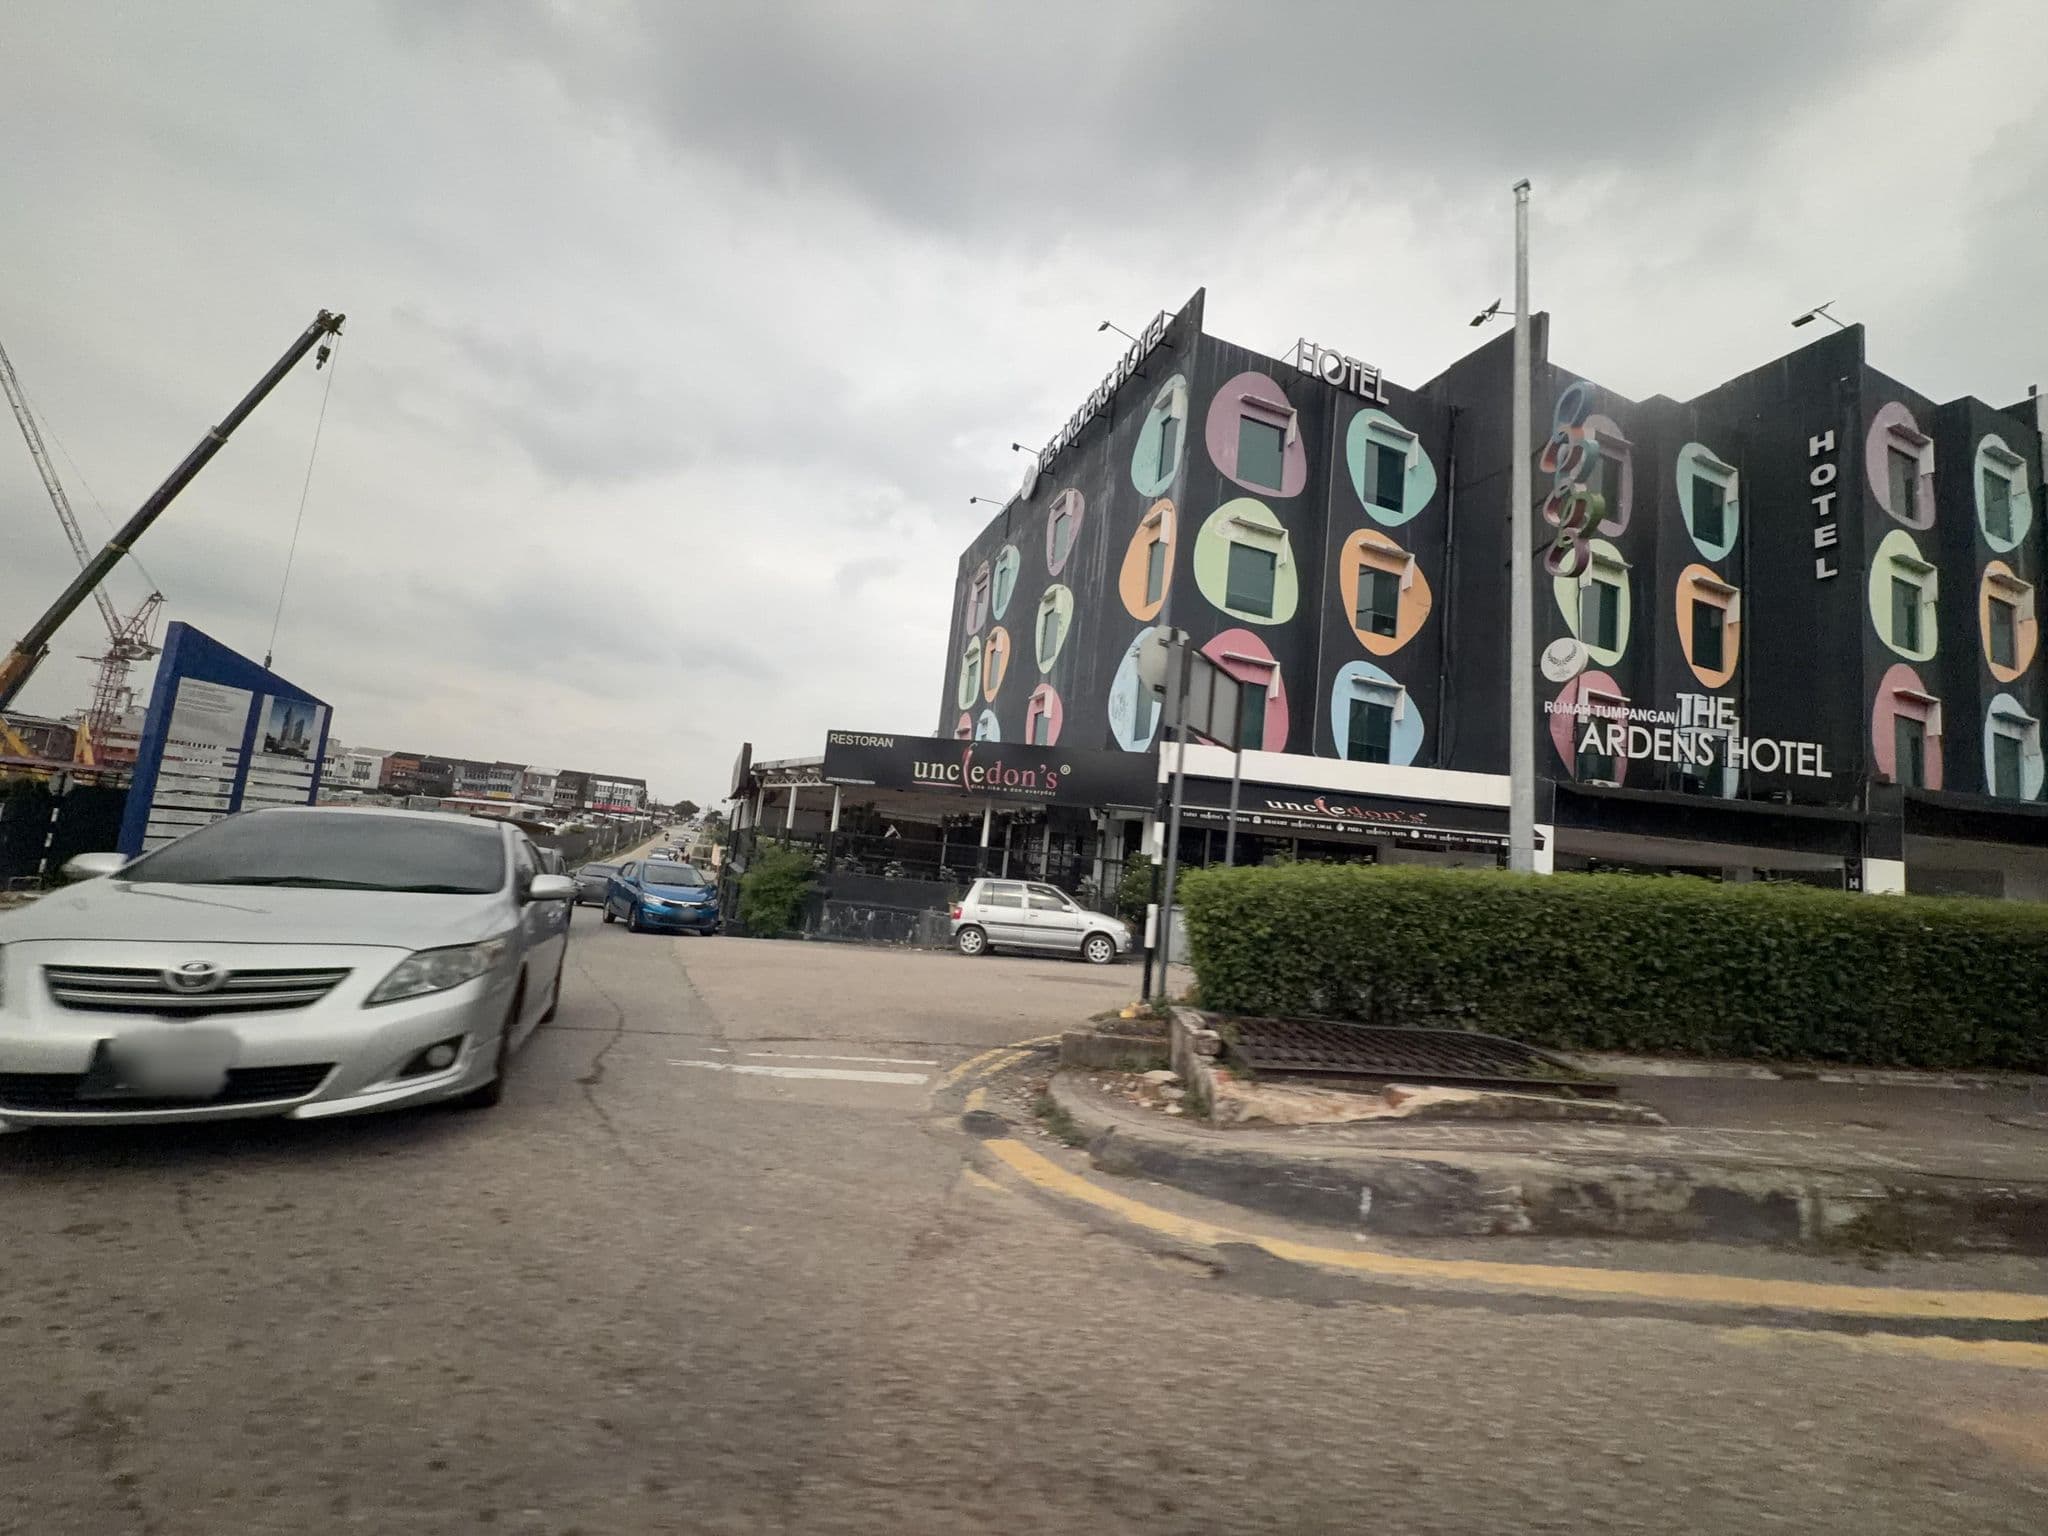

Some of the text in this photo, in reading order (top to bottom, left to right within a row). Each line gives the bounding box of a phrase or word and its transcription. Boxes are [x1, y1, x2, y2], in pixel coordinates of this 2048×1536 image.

[1113, 310, 1166, 392] HOTEL
[1297, 338, 1390, 405] HOTEL
[1809, 429, 1839, 580] HOTEL
[1544, 700, 1676, 724] RUMAH TUMPANGAN
[1676, 692, 1736, 731] THE
[830, 733, 894, 748] RESTORAN
[1578, 721, 1832, 778] ARDENS HOTEL
